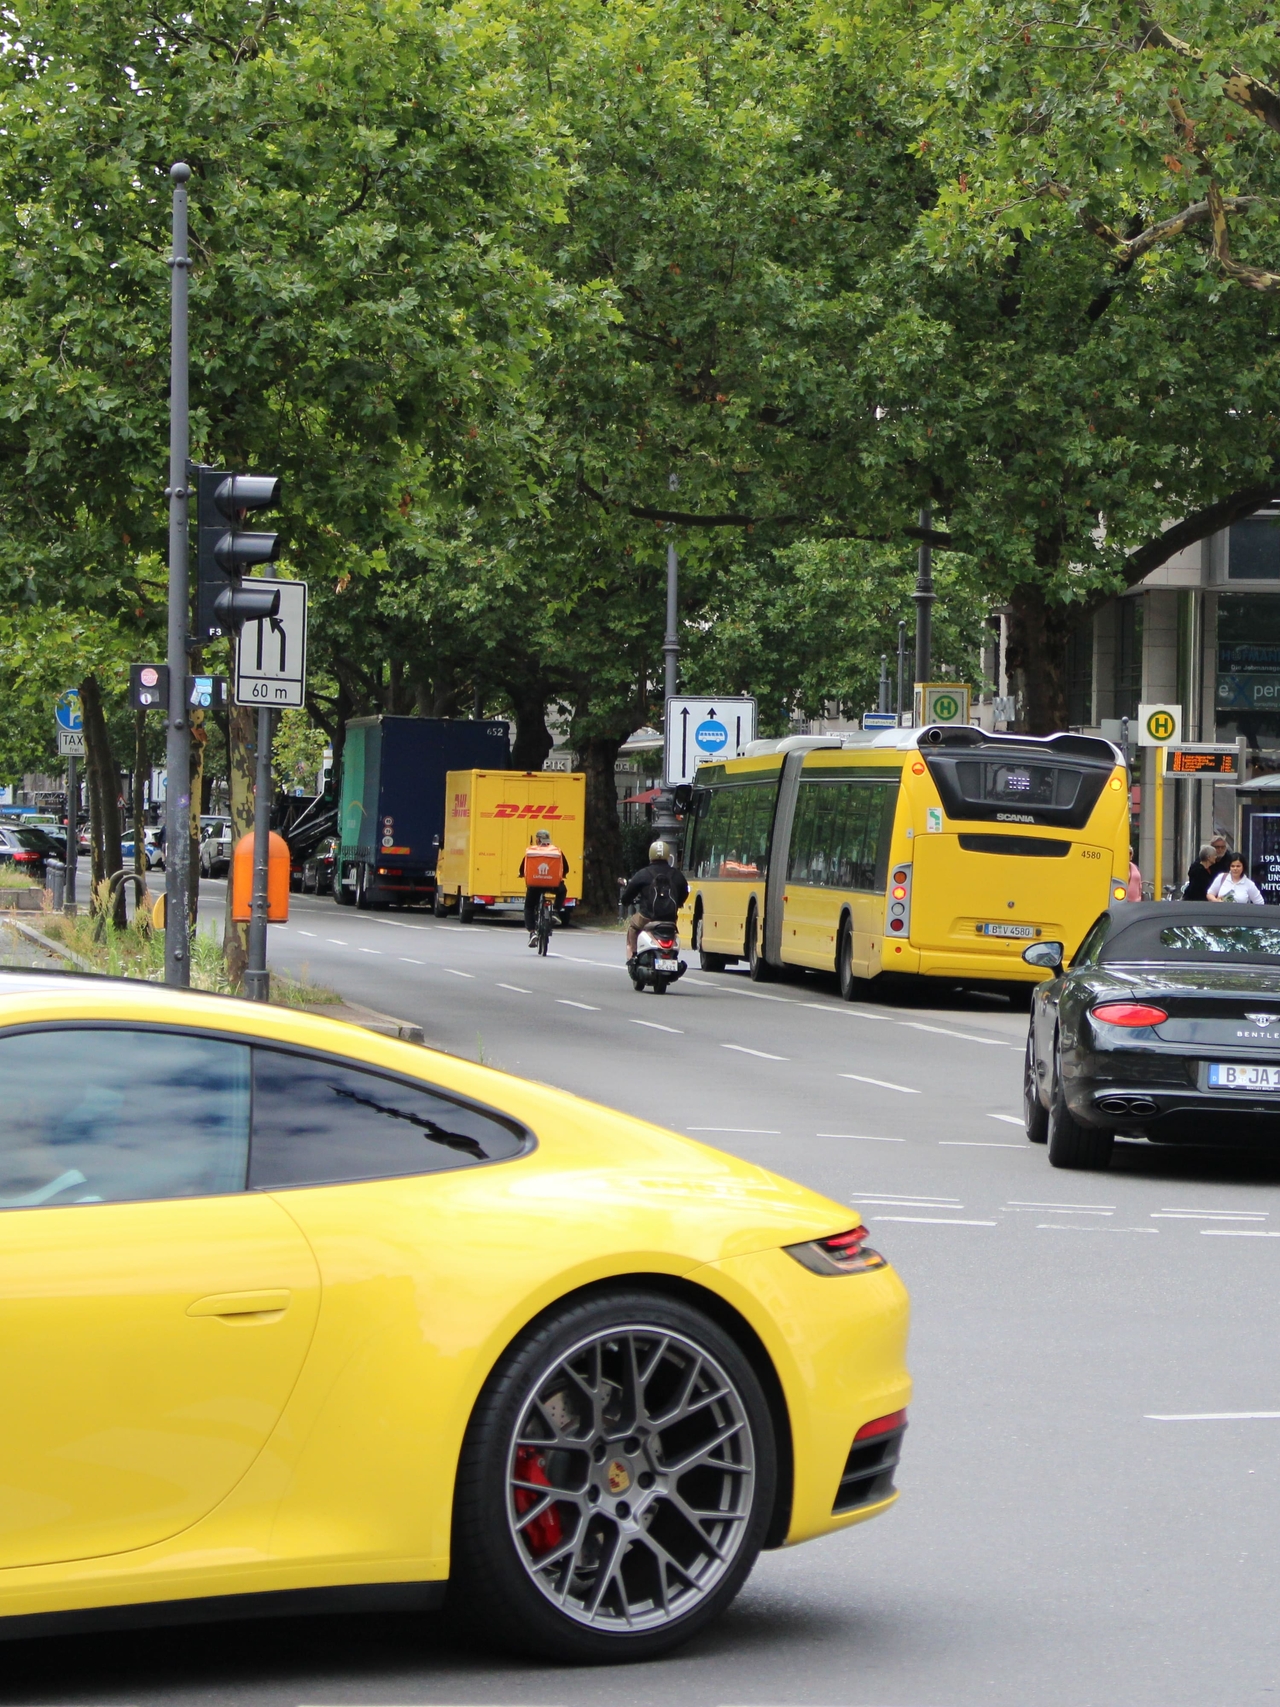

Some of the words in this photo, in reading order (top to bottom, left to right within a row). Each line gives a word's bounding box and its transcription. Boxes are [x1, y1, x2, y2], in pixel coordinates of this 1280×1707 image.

[209, 628, 222, 636] F3
[252, 684, 268, 698] 60
[274, 687, 288, 699] m
[486, 727, 504, 737] 652
[493, 803, 563, 820] DHL
[996, 812, 1035, 824] SCANIA
[1081, 850, 1101, 860] 4580
[1260, 855, 1275, 863] 199
[992, 925, 998, 934] B
[1003, 926, 1009, 935] V
[1010, 927, 1030, 937] 4580
[1226, 1066, 1237, 1083] B
[1248, 1067, 1270, 1085] JA
